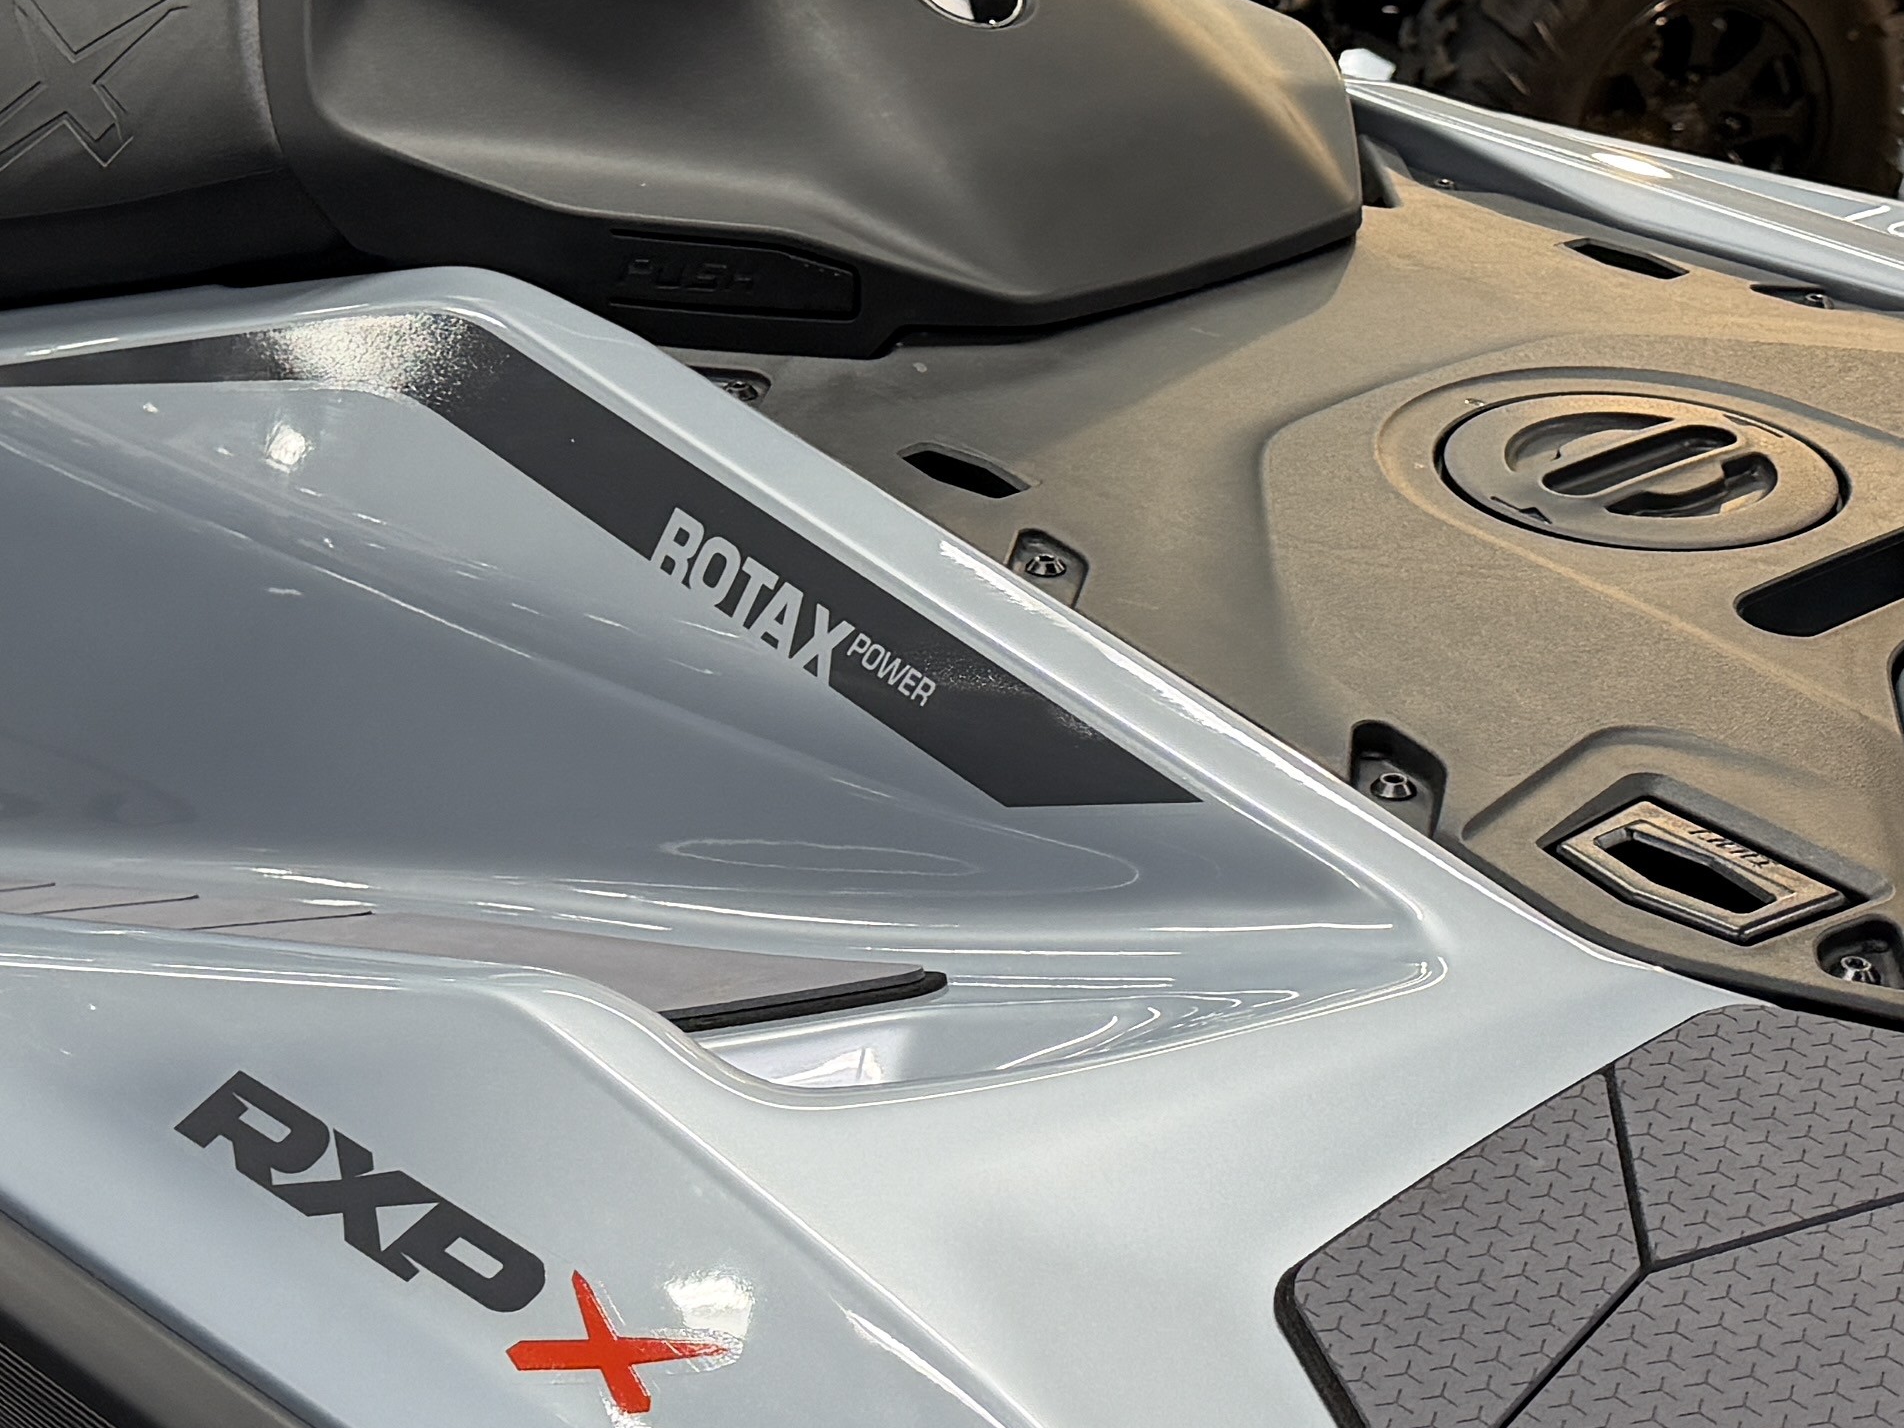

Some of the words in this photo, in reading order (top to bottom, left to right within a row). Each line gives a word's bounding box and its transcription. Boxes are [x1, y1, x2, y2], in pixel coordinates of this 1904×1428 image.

[649, 506, 856, 686] ROTAX
[846, 632, 936, 706] POWER
[173, 1070, 545, 1313] RXP
[505, 1270, 732, 1415] X
